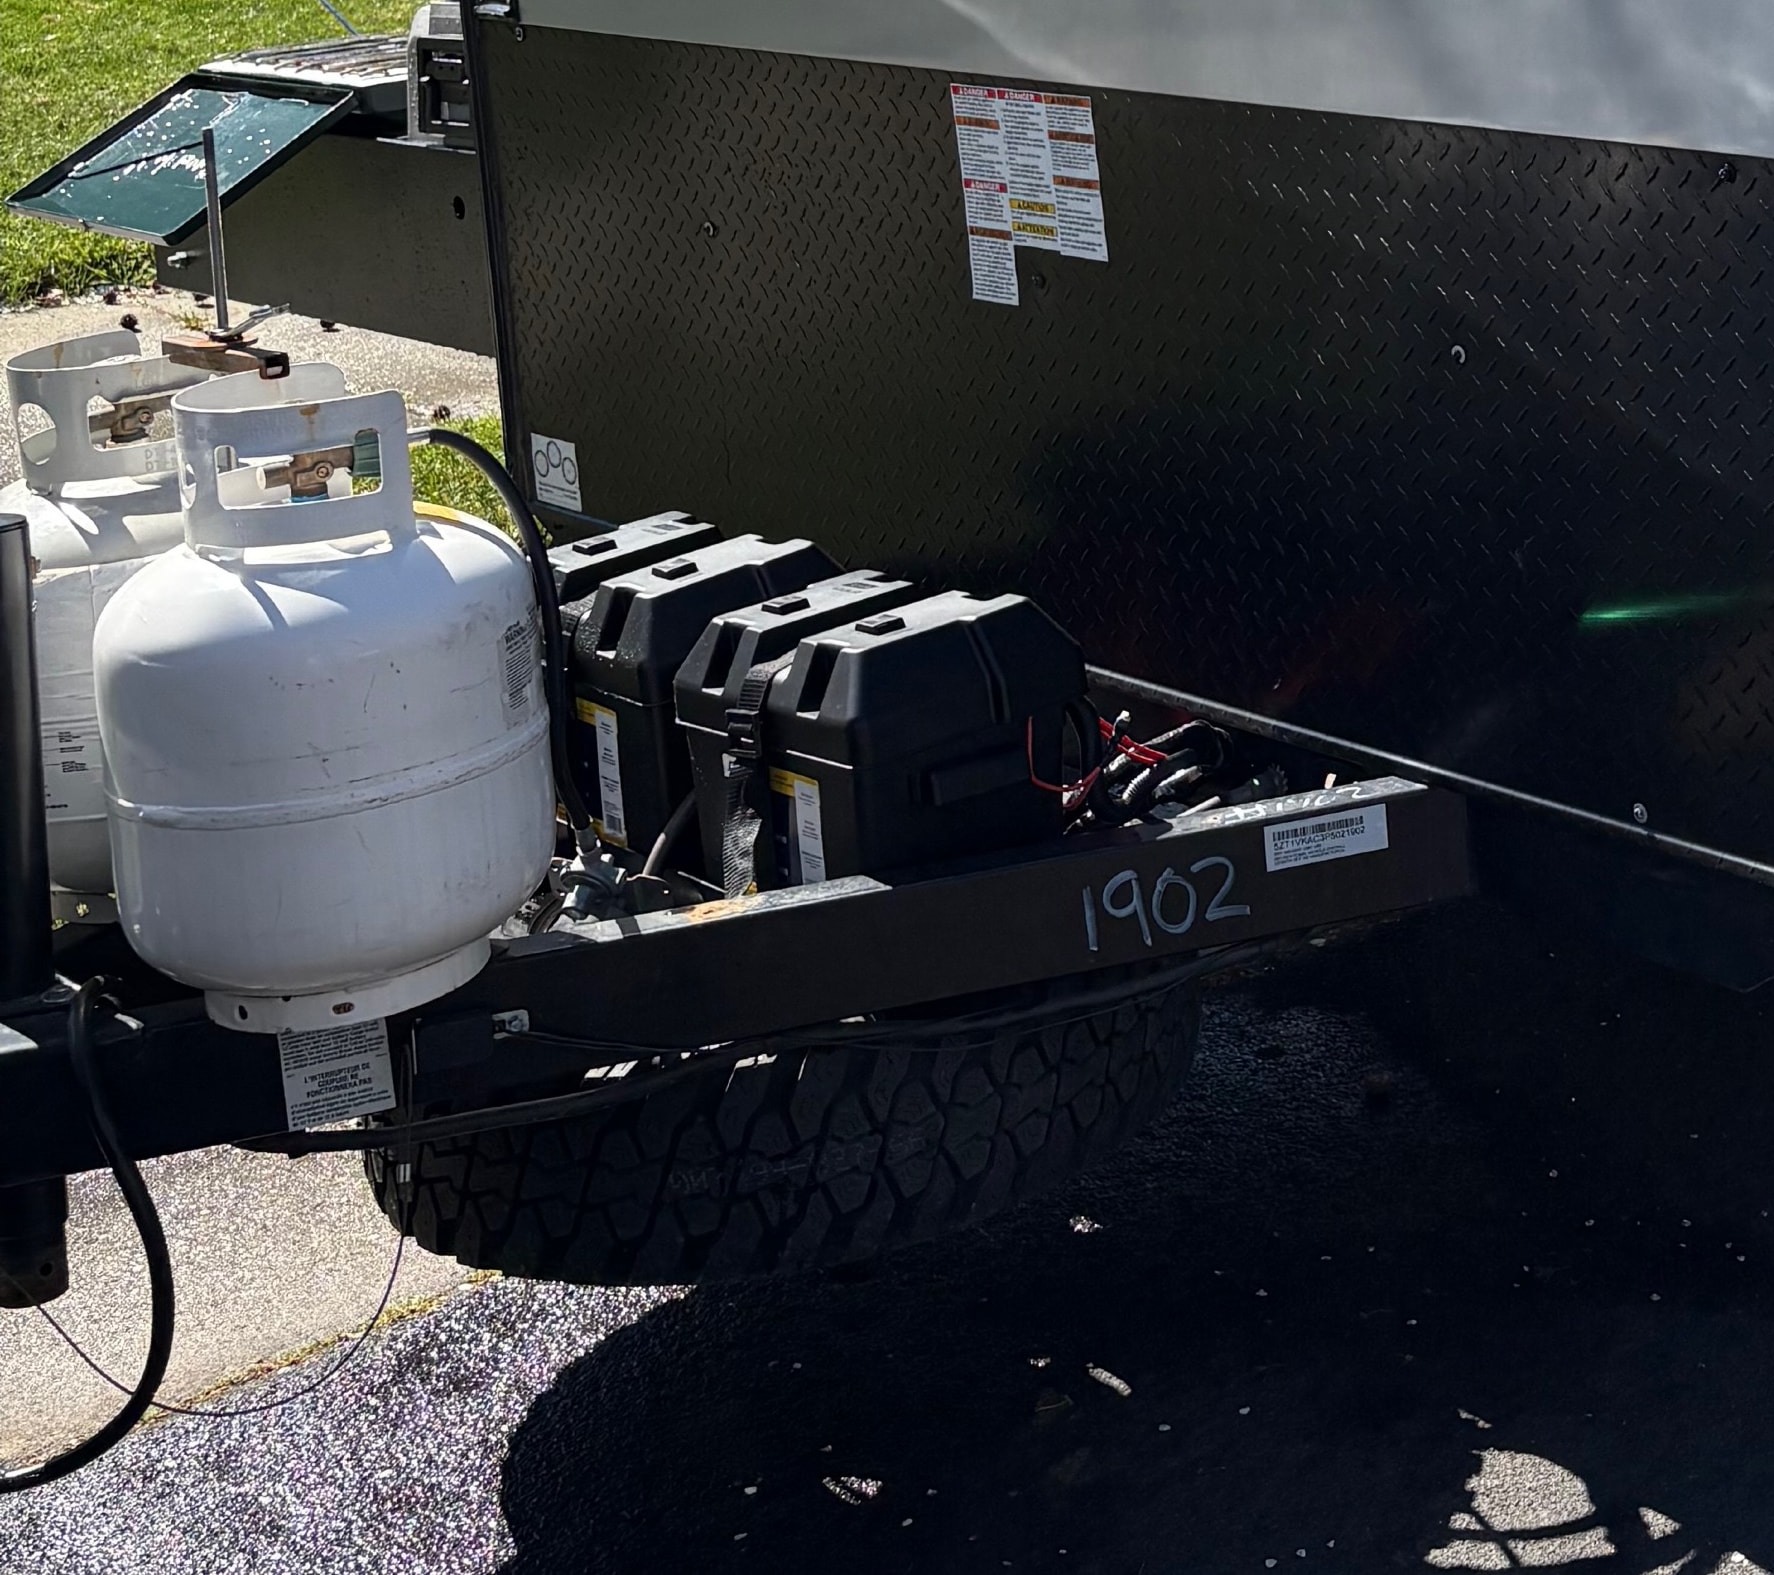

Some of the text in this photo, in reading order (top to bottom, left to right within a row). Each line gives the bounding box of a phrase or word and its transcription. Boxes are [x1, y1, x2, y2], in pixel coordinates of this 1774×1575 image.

[1009, 91, 1035, 100] DANGER
[976, 182, 1000, 191] DANGER
[1082, 856, 1250, 952] 1902
